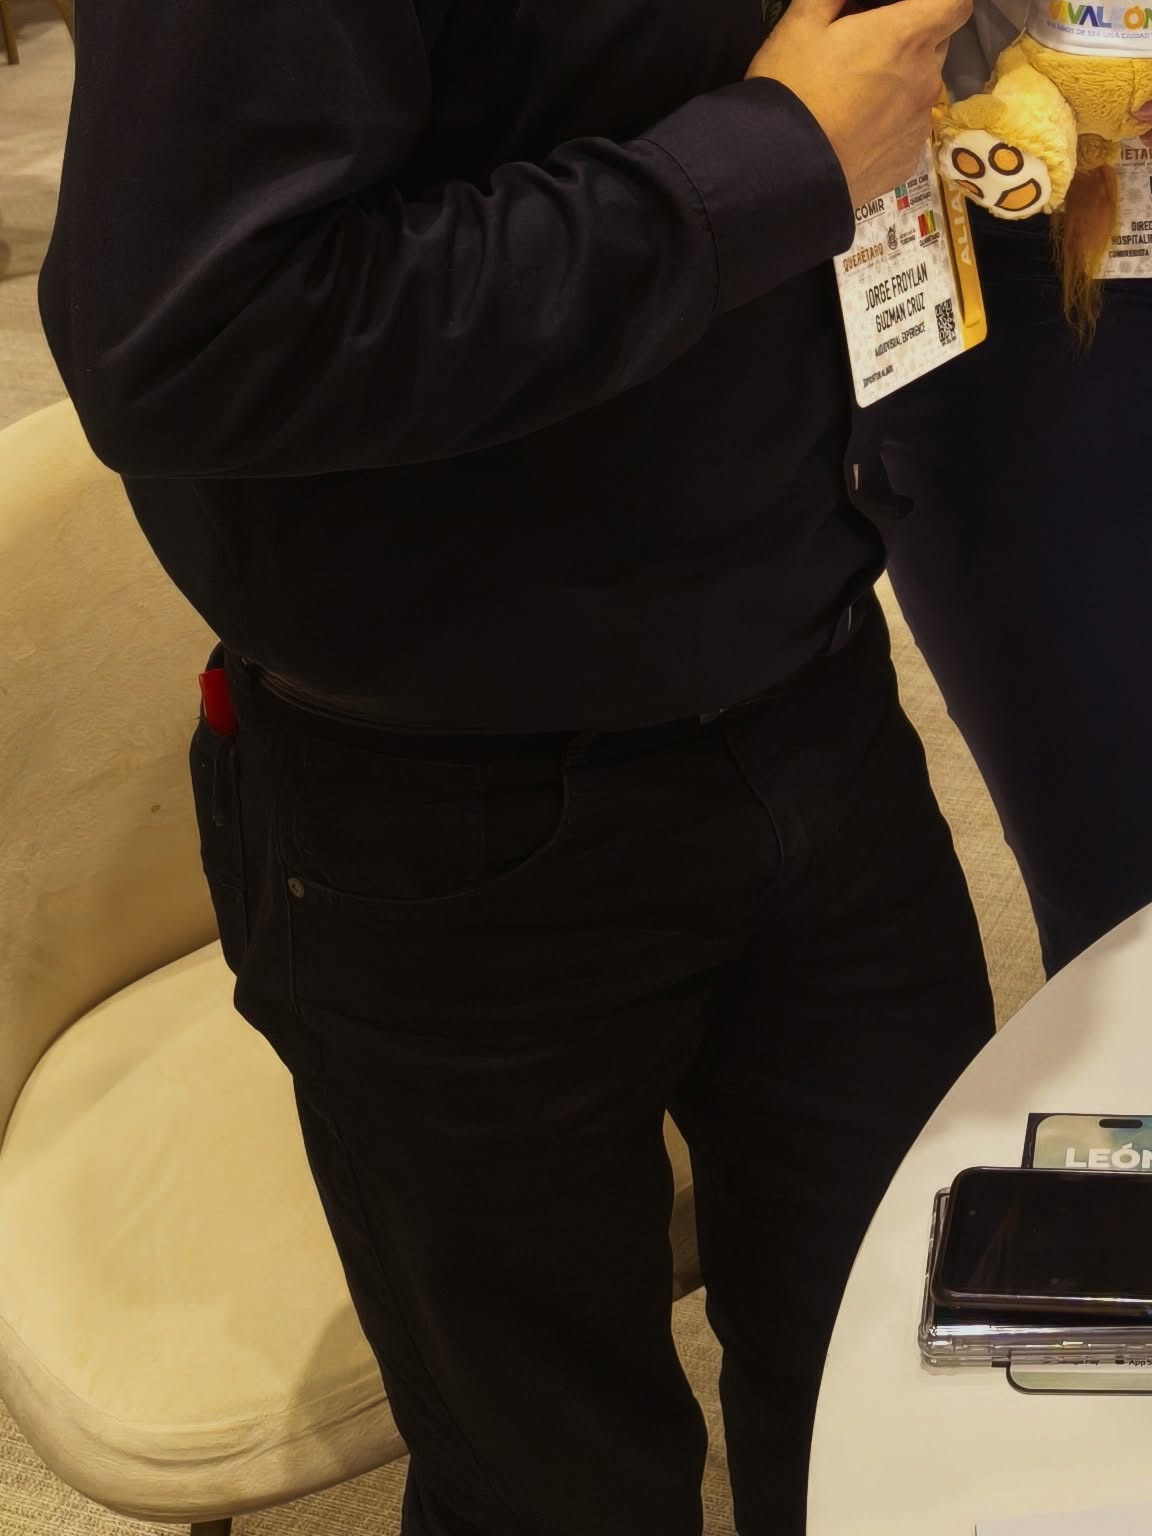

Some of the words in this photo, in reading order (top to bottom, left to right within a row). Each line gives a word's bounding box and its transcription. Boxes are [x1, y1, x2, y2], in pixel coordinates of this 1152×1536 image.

[865, 280, 892, 312] JORGE
[891, 262, 928, 298] FROYLAN
[875, 302, 907, 333] GUZMAN
[906, 292, 926, 317] CRUZ
